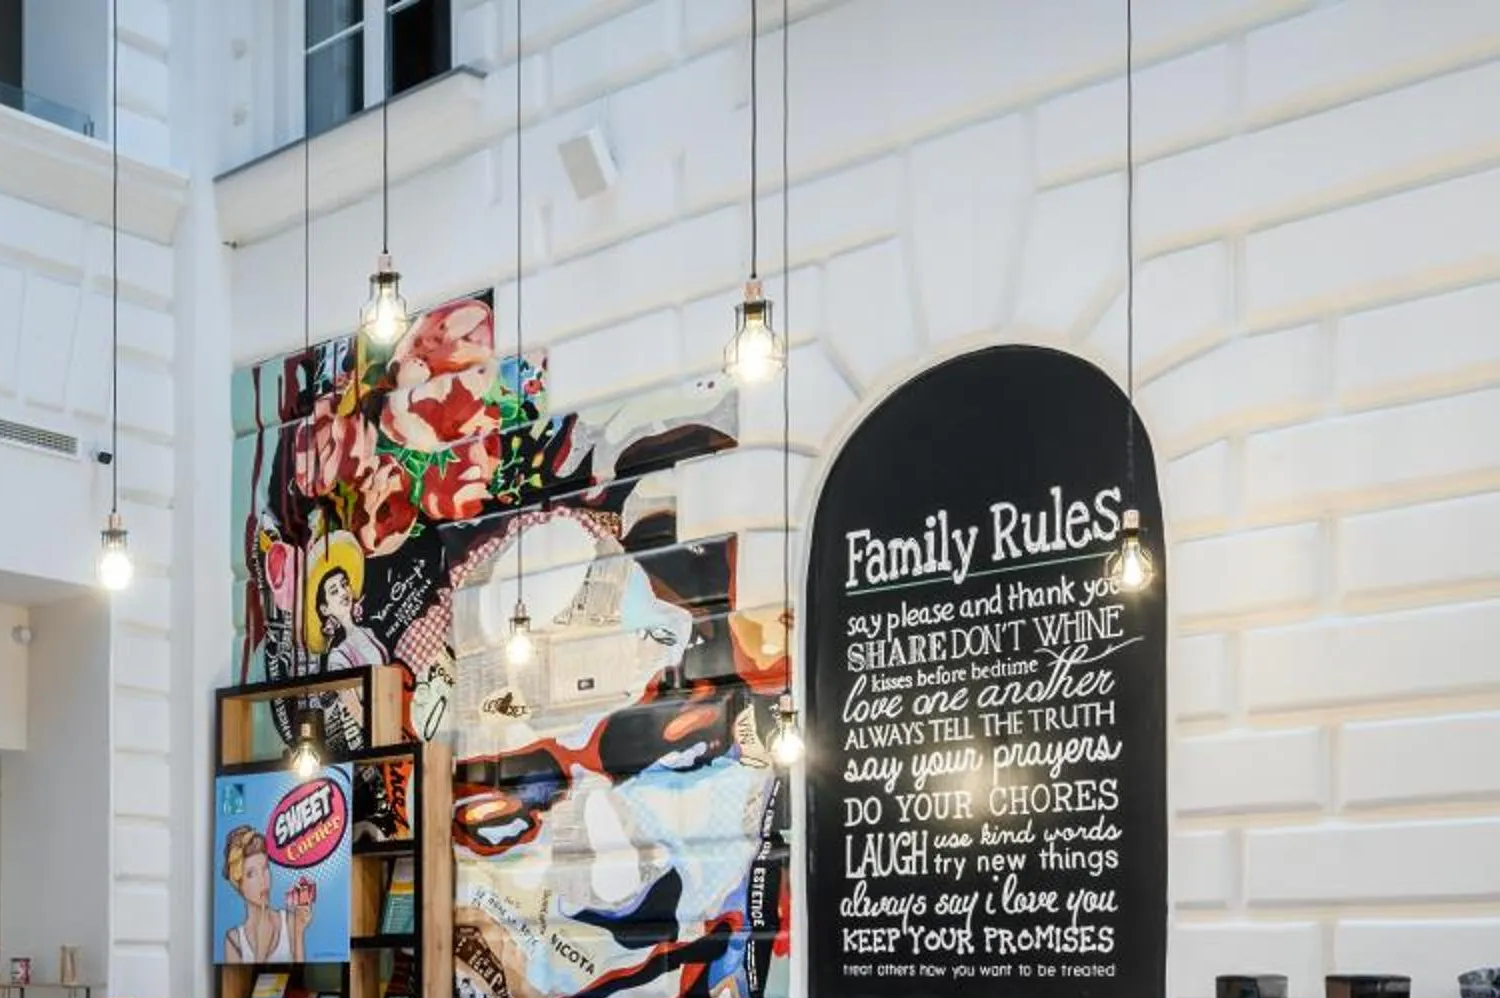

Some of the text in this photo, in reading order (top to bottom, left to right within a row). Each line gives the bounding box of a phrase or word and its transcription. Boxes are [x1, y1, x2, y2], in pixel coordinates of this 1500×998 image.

[845, 485, 1122, 585] Family Rules
[847, 612, 882, 639] say
[887, 601, 955, 642] please
[959, 584, 1003, 618] and
[1008, 575, 1075, 611] thank
[847, 604, 1125, 672] SHARE DON'T WHINE
[842, 640, 1130, 723] love one another
[871, 657, 1039, 693] kisses before bedtime
[844, 700, 1116, 751] ALWAYS TELL THE TRUTH
[844, 734, 1123, 793] say your prayers
[275, 783, 333, 847] SWEET
[844, 779, 1120, 826] DO YOUR CHORES
[286, 814, 341, 862] Corner
[845, 830, 928, 879] LAUGH
[934, 816, 1123, 848] use kind words
[934, 842, 1120, 880] try new things
[840, 873, 1119, 934] always say i love you
[842, 925, 1115, 955] KEEP YOUR PROMISES
[843, 963, 1115, 980] treat others how you want to be treated
